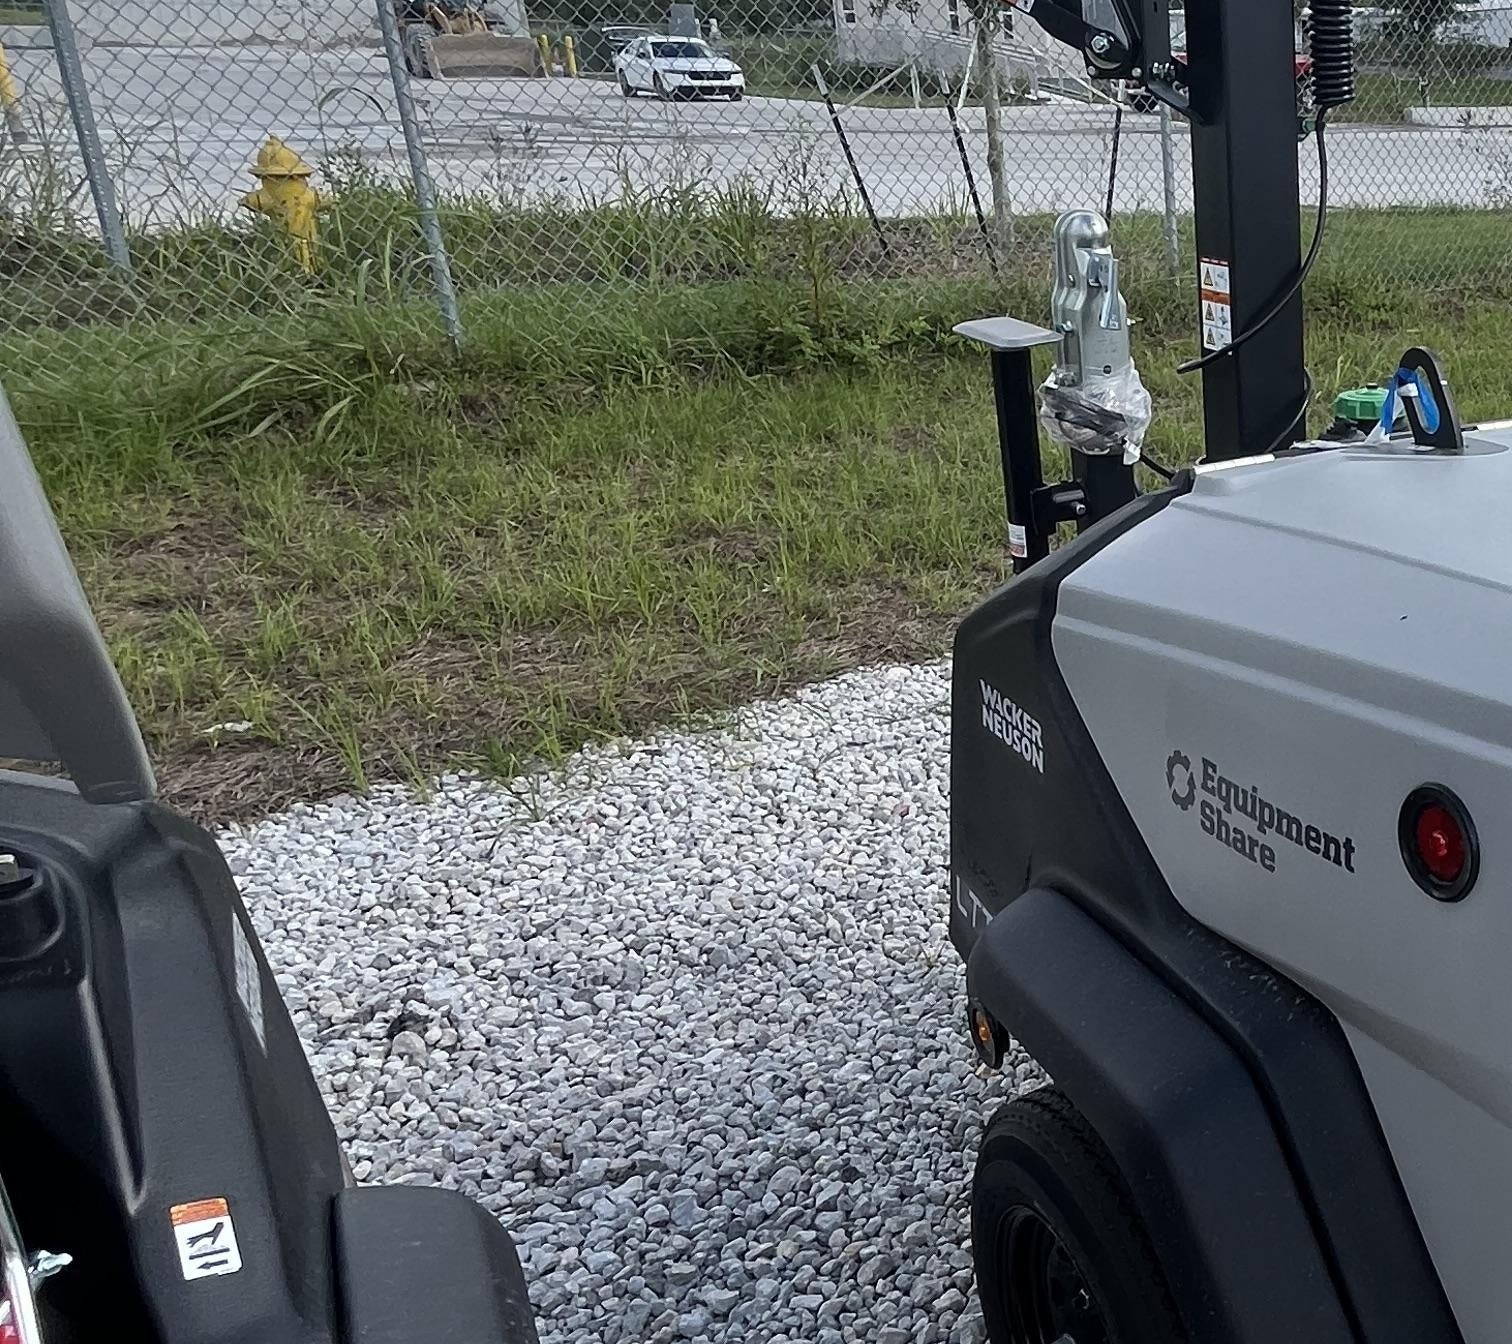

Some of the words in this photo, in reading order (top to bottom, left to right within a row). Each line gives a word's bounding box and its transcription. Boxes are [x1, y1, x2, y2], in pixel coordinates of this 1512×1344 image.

[979, 678, 1043, 748] WACKER
[981, 704, 1044, 774] NEUSON
[1200, 799, 1276, 873] Share
[1201, 757, 1356, 874] Equipment
